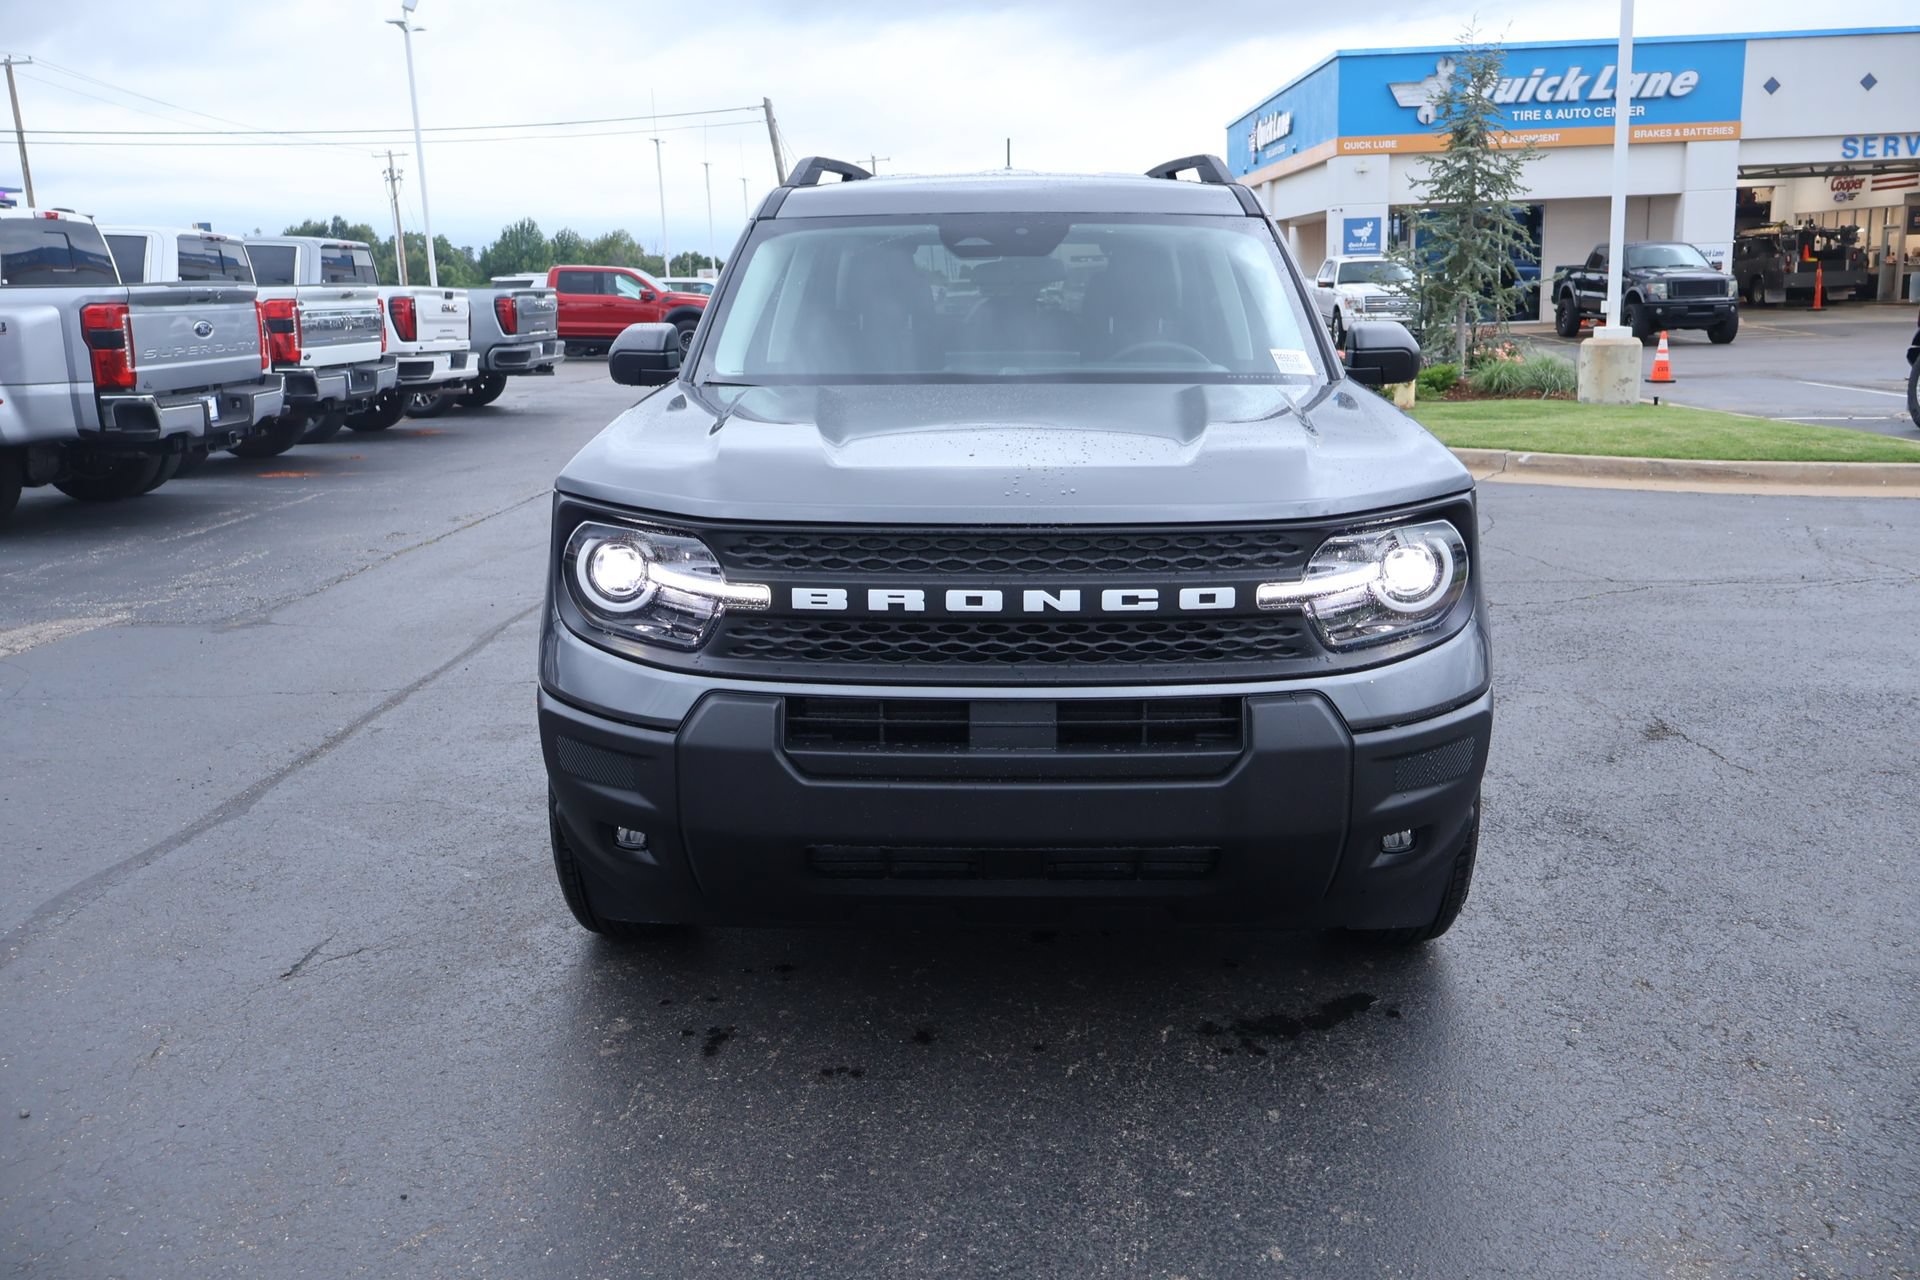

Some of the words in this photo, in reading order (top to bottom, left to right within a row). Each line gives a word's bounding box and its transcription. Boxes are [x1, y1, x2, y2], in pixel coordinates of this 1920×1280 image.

[1512, 110, 1541, 121] TIRE
[1544, 110, 1553, 120] &
[1556, 107, 1591, 119] AUTO
[1594, 105, 1645, 118] CEER
[1509, 133, 1560, 144] ALIGNMENT
[1633, 128, 1672, 138] BRAKES
[1674, 129, 1681, 137] &
[1683, 126, 1734, 137] BATTERIES
[1343, 140, 1372, 150] QUICK
[1373, 140, 1398, 149] LUBE
[1841, 134, 1920, 159] SERV
[1830, 176, 1866, 192] Cooper
[143, 345, 212, 359] SUPER
[215, 340, 256, 354] DUTY
[791, 587, 1236, 612] BRONCO
